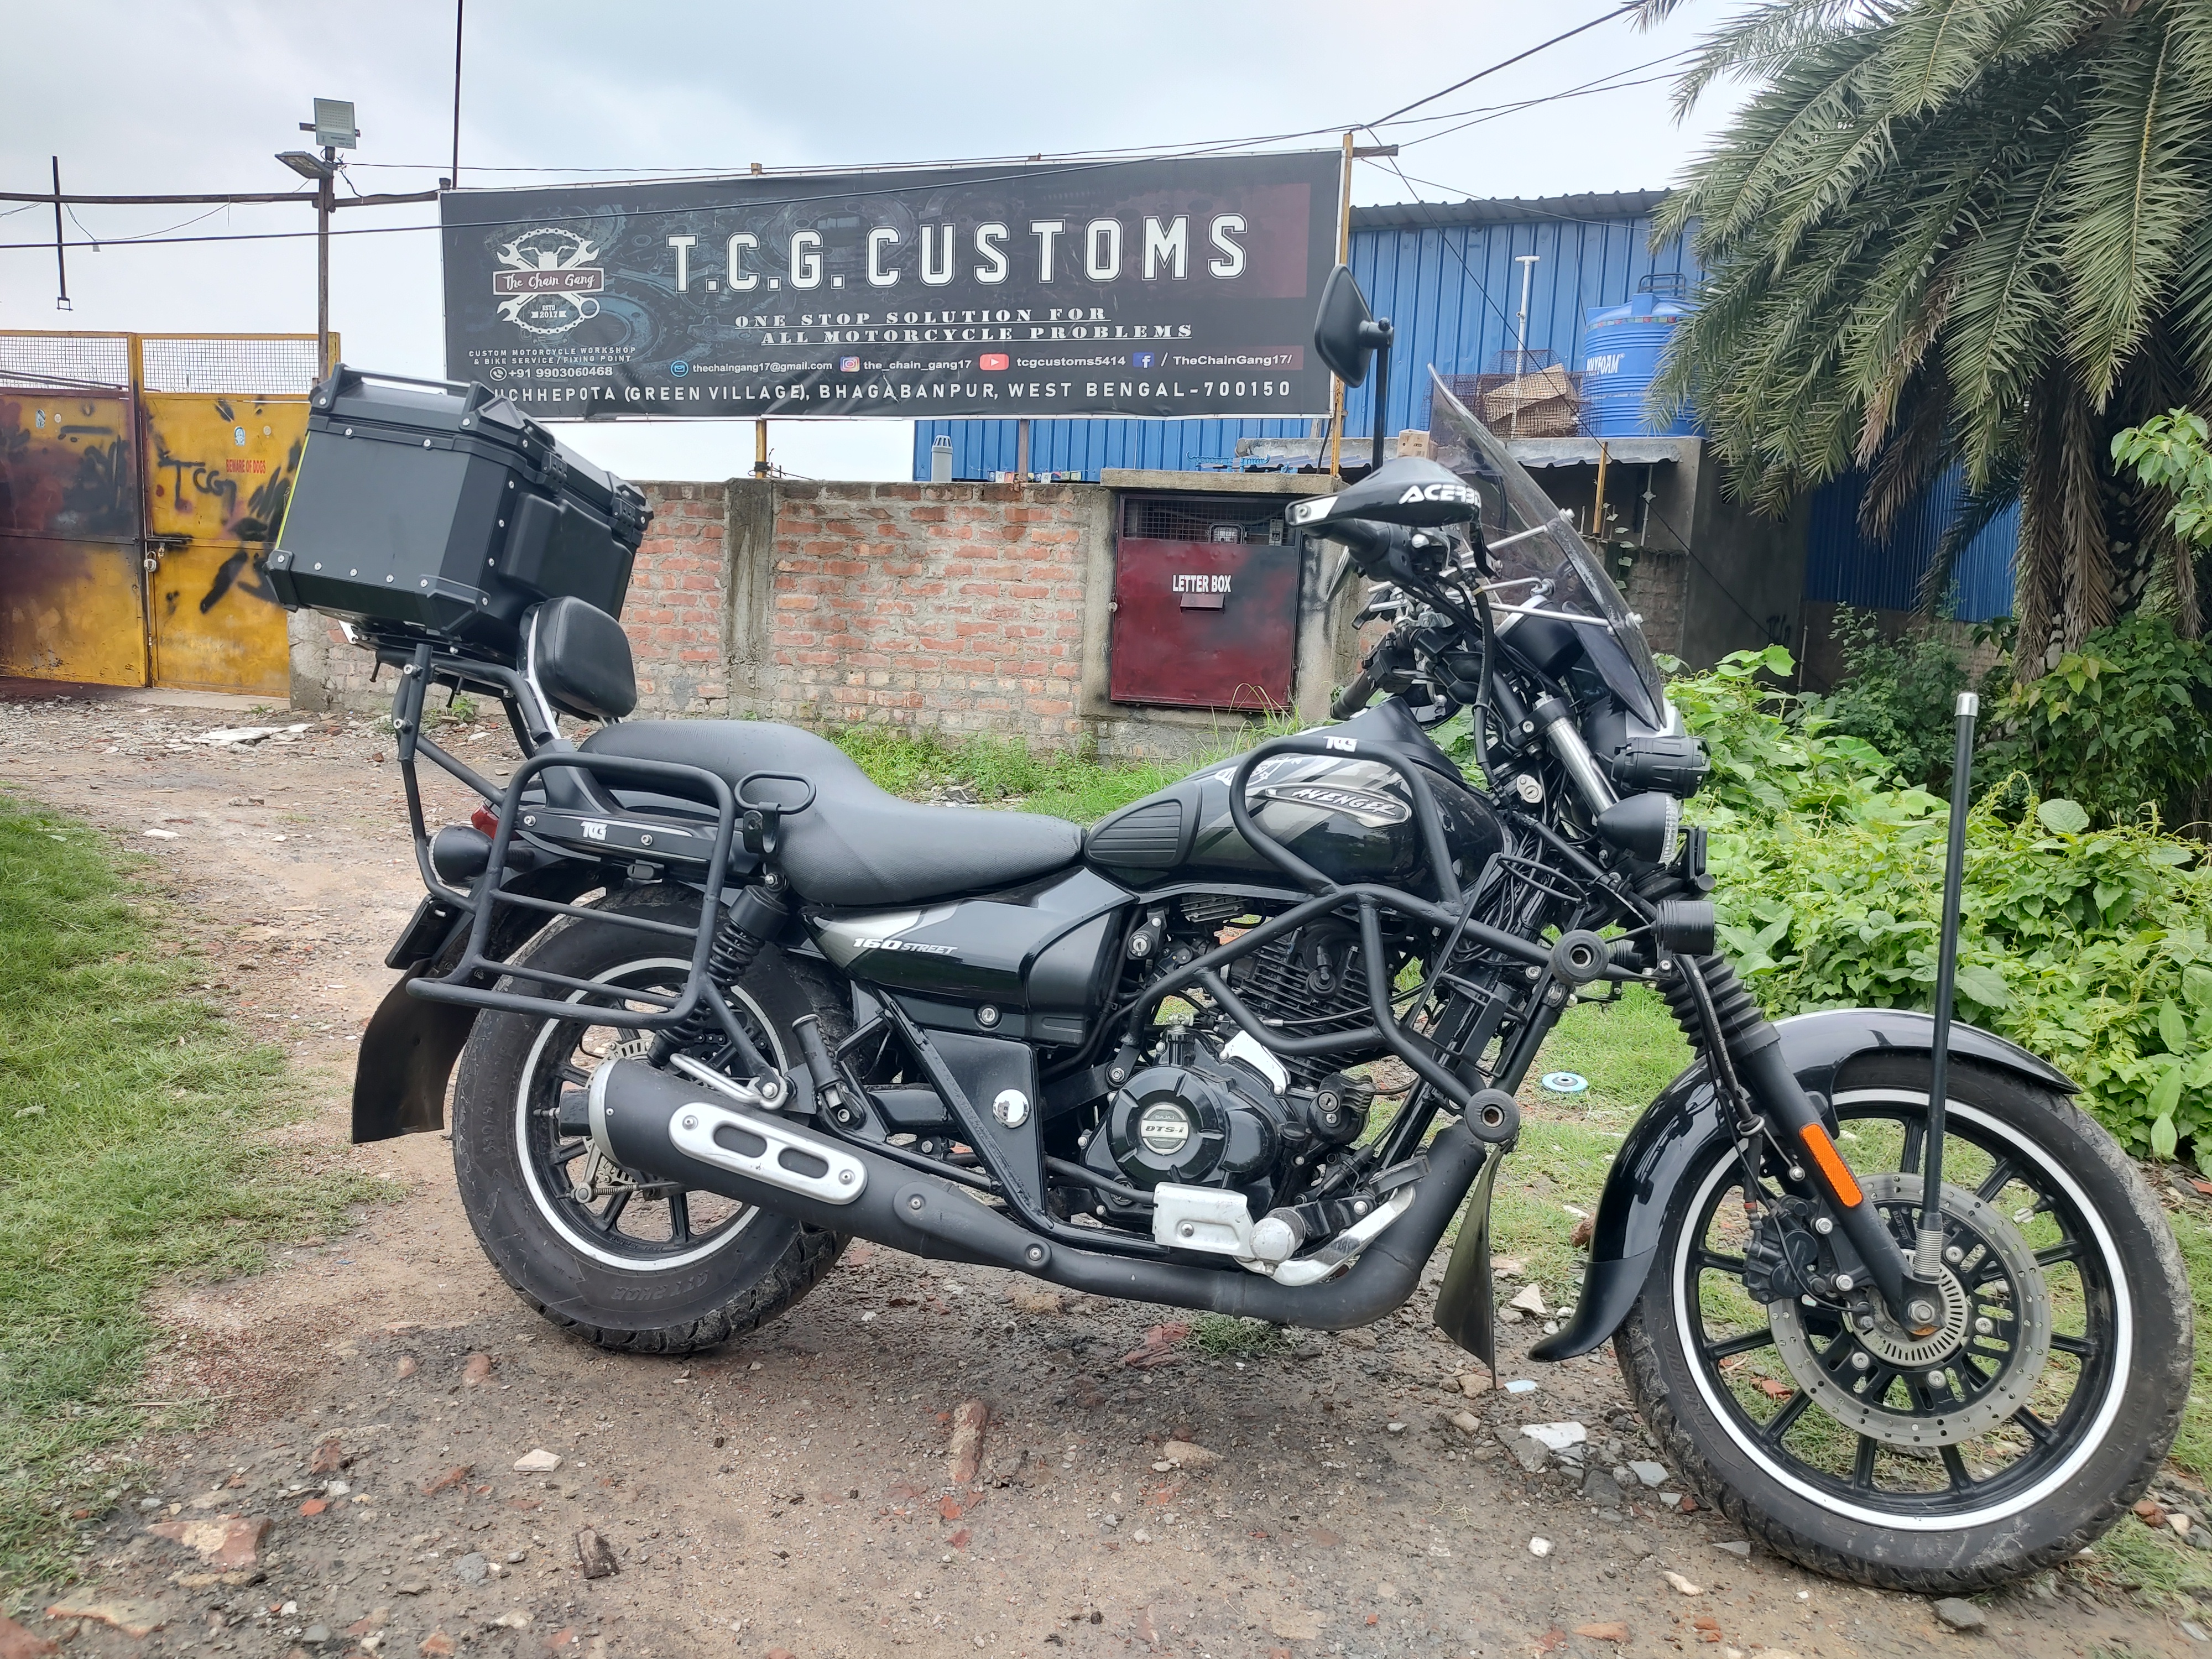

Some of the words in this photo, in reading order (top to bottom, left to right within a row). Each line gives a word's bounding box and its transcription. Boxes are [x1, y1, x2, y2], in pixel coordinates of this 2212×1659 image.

[866, 213, 1248, 288] CUSTOMS
[502, 274, 524, 290] The
[528, 273, 559, 289] Chain
[565, 273, 596, 289] Gang
[734, 315, 786, 327] ONE
[801, 312, 870, 326] STOP
[886, 309, 1032, 324] SOLUTION
[1050, 307, 1105, 321] FOR
[761, 332, 809, 343] ALL
[823, 327, 1013, 343] MOTORCYCLE
[1030, 324, 1192, 339] PROBLEMS
[512, 348, 577, 356] MOTORCYCLE
[580, 346, 637, 354] WORKSHOP
[601, 354, 632, 363] POINT
[692, 361, 833, 373] thechaingang17@gmail.com
[863, 360, 972, 371] the_chain_gang17
[1016, 356, 1126, 369] tcgcustoms5414
[508, 368, 531, 378] +91
[535, 366, 613, 378] 9903060468
[624, 385, 700, 403] (GREEN
[819, 383, 999, 400] BHAGABANPUR,
[1008, 382, 1072, 398] WEST
[226, 459, 245, 473] BEWARE
[246, 460, 252, 473] OF
[253, 460, 266, 474] DOGS
[1172, 575, 1209, 592] LETTER
[1211, 575, 1232, 592] BOX
[1323, 736, 1358, 753] TCG
[1291, 788, 1396, 816] AVENGER
[580, 821, 608, 840] TCG
[853, 938, 904, 950] 160
[901, 942, 958, 954] STREET
